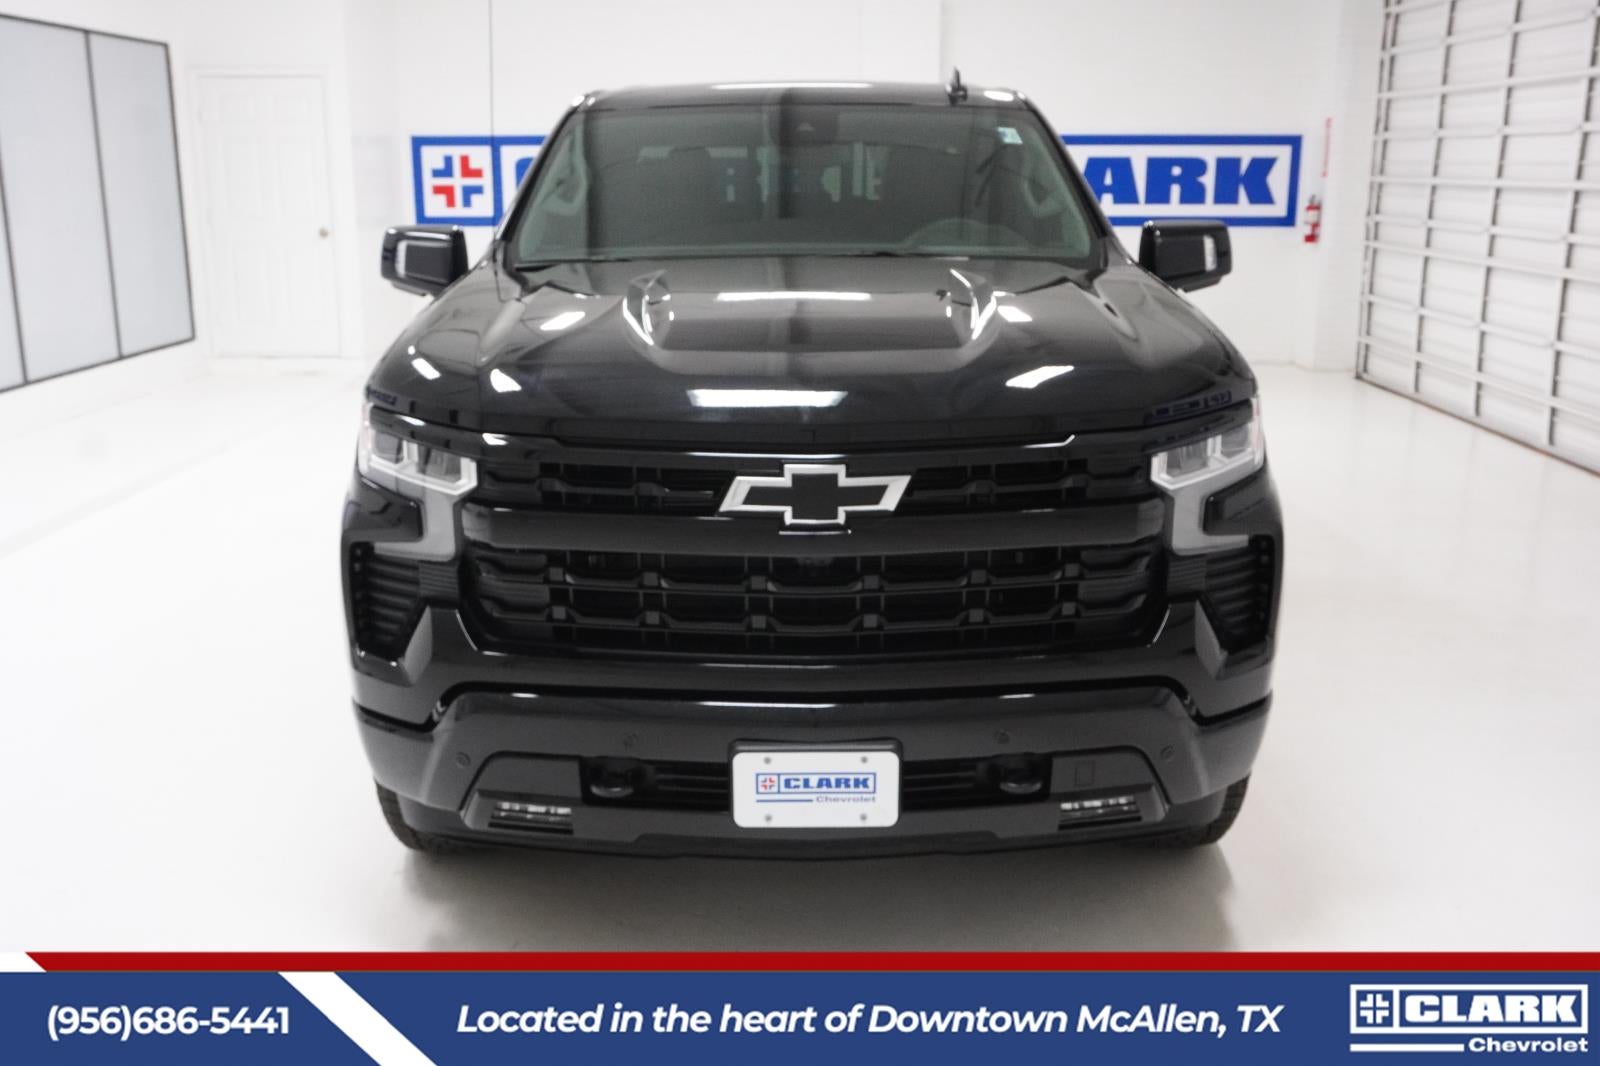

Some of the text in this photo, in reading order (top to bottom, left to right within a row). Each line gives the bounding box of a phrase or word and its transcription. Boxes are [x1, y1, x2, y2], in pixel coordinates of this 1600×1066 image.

[1083, 157, 1278, 205] ARK
[783, 777, 870, 789] CLARK
[816, 795, 876, 803] Chevrolet
